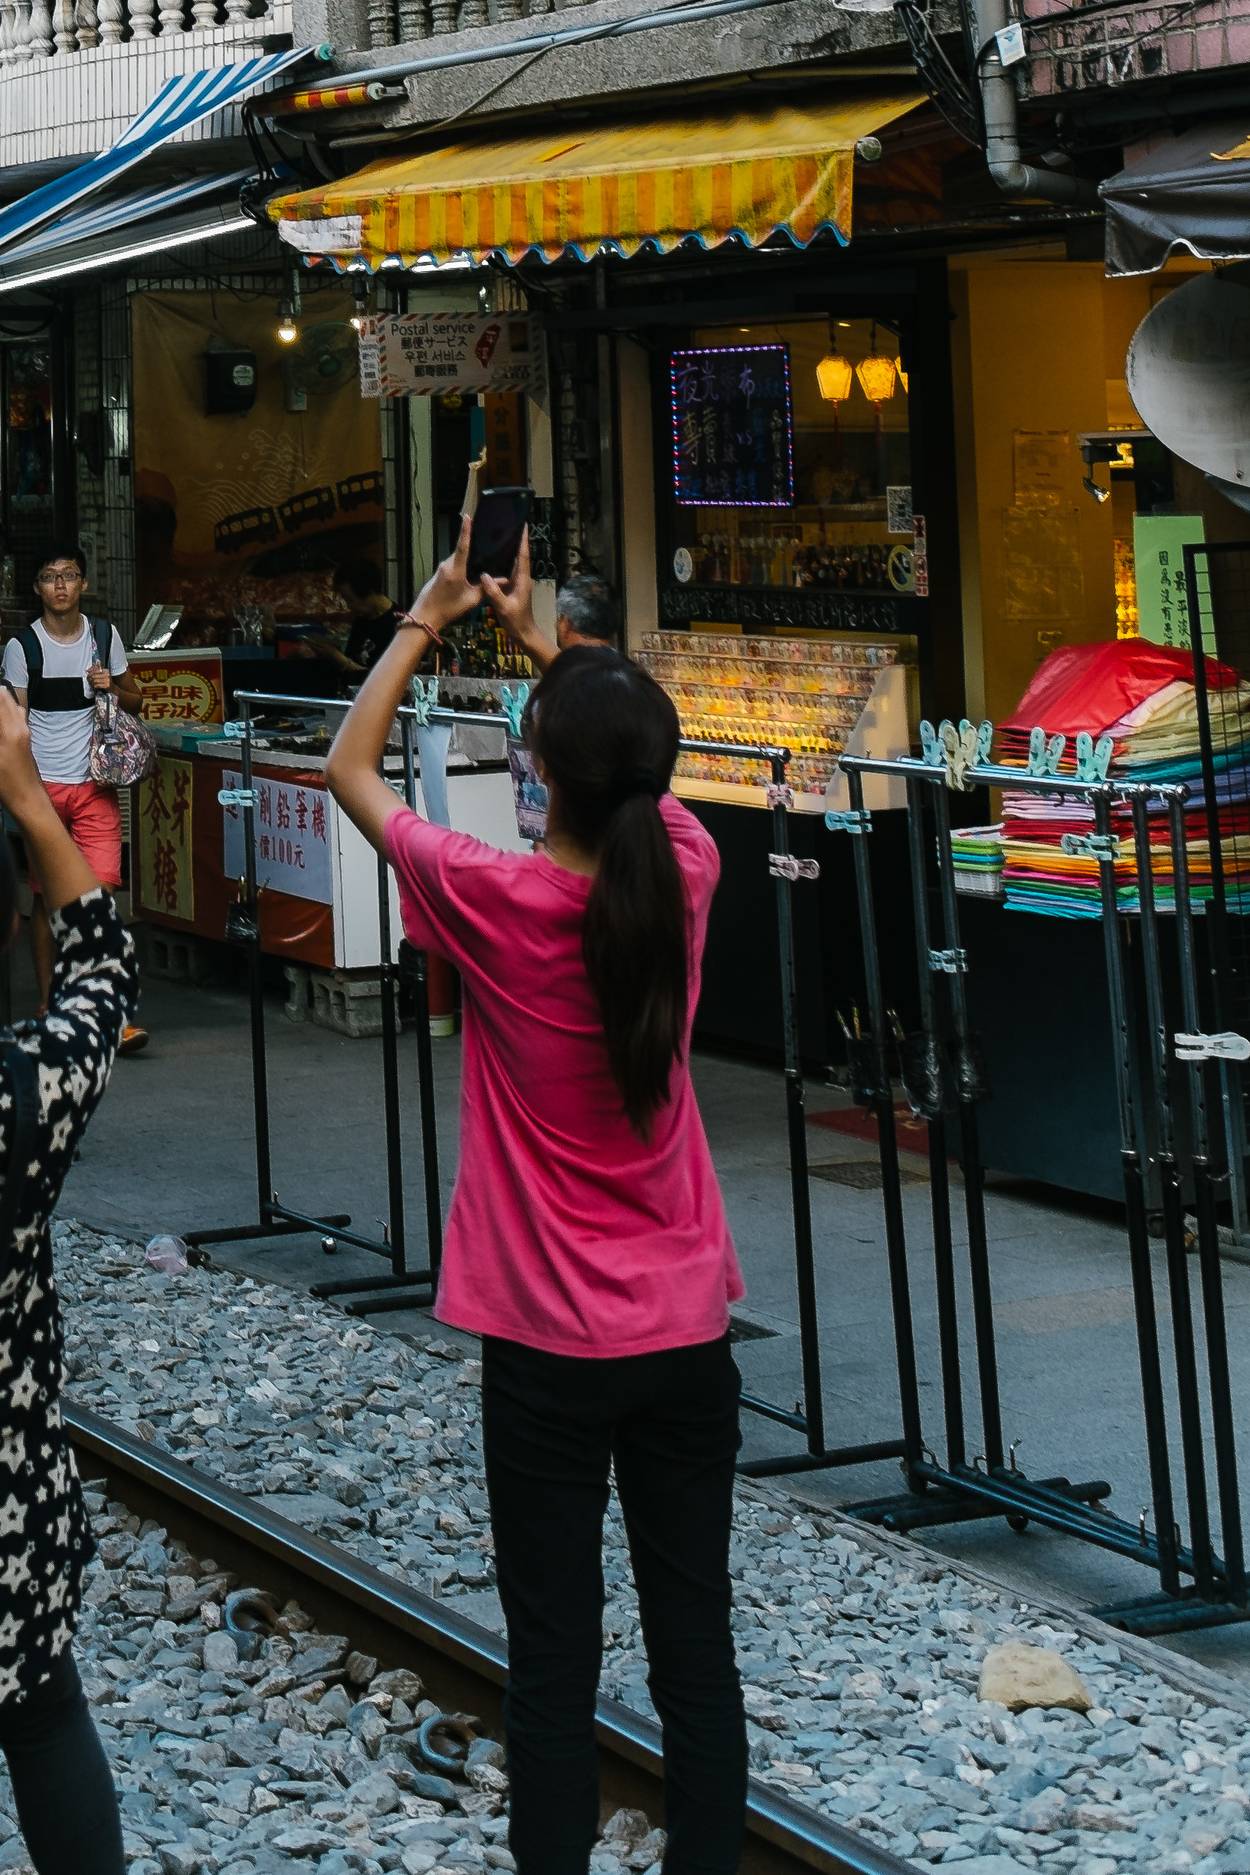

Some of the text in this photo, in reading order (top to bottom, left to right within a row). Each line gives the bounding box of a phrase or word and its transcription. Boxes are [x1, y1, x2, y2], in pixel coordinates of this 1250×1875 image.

[390, 321, 475, 336] Postal service
[401, 335, 468, 350] 郵便サービス
[404, 350, 467, 364] 우편 서비스
[253, 833, 306, 869] 價100元
